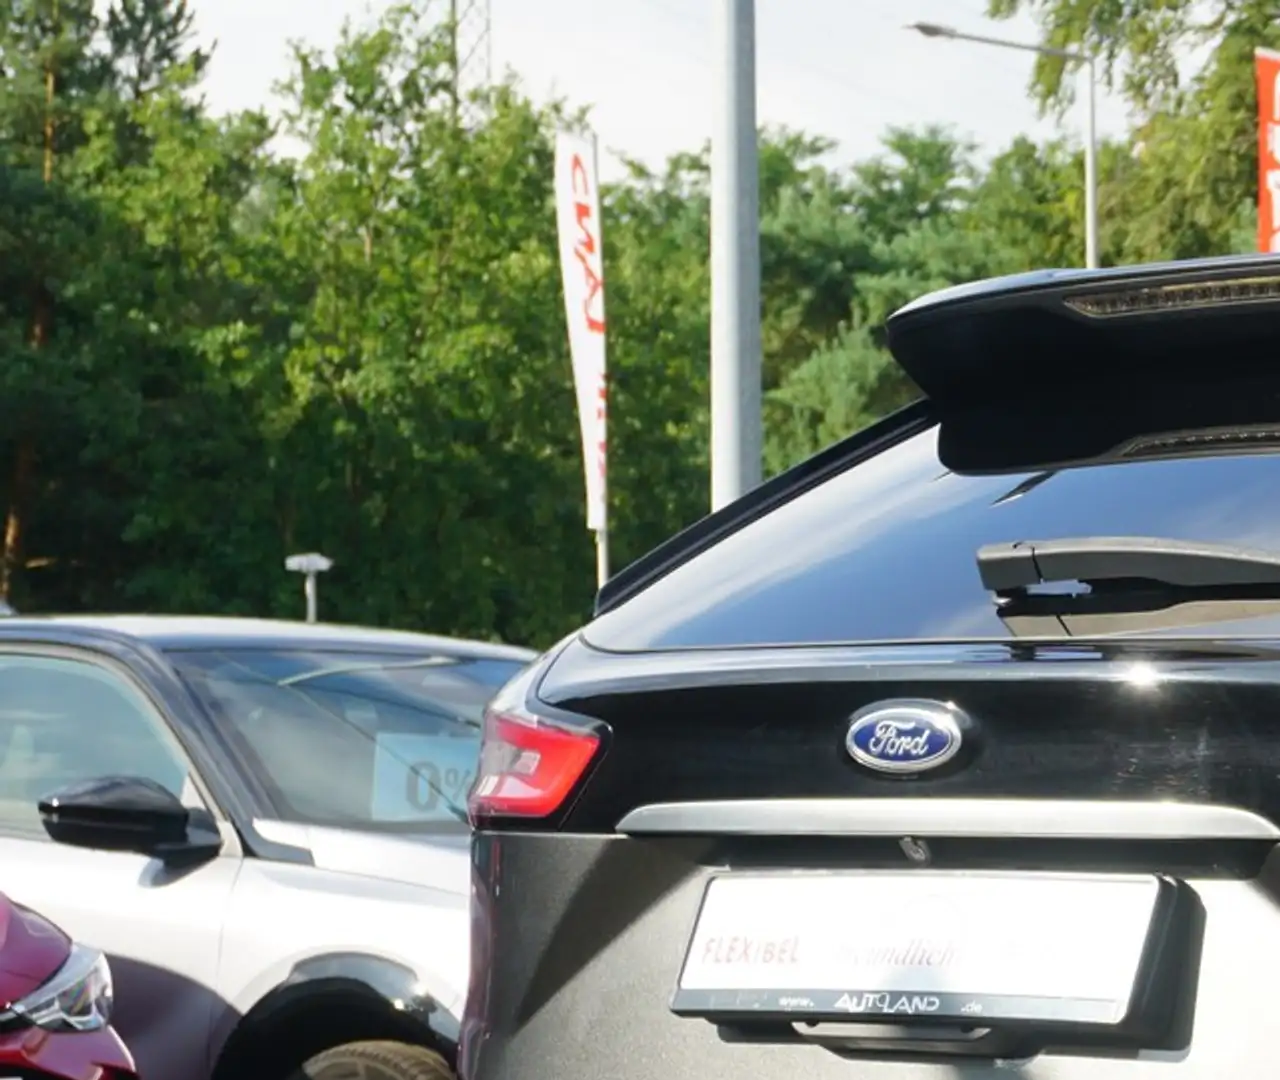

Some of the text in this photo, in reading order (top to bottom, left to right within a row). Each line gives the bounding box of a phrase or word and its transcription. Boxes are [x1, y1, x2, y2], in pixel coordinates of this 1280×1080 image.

[869, 720, 930, 757] Ford
[701, 935, 800, 965] FLEXIBEL
[834, 992, 941, 1014] AUTOLAND
